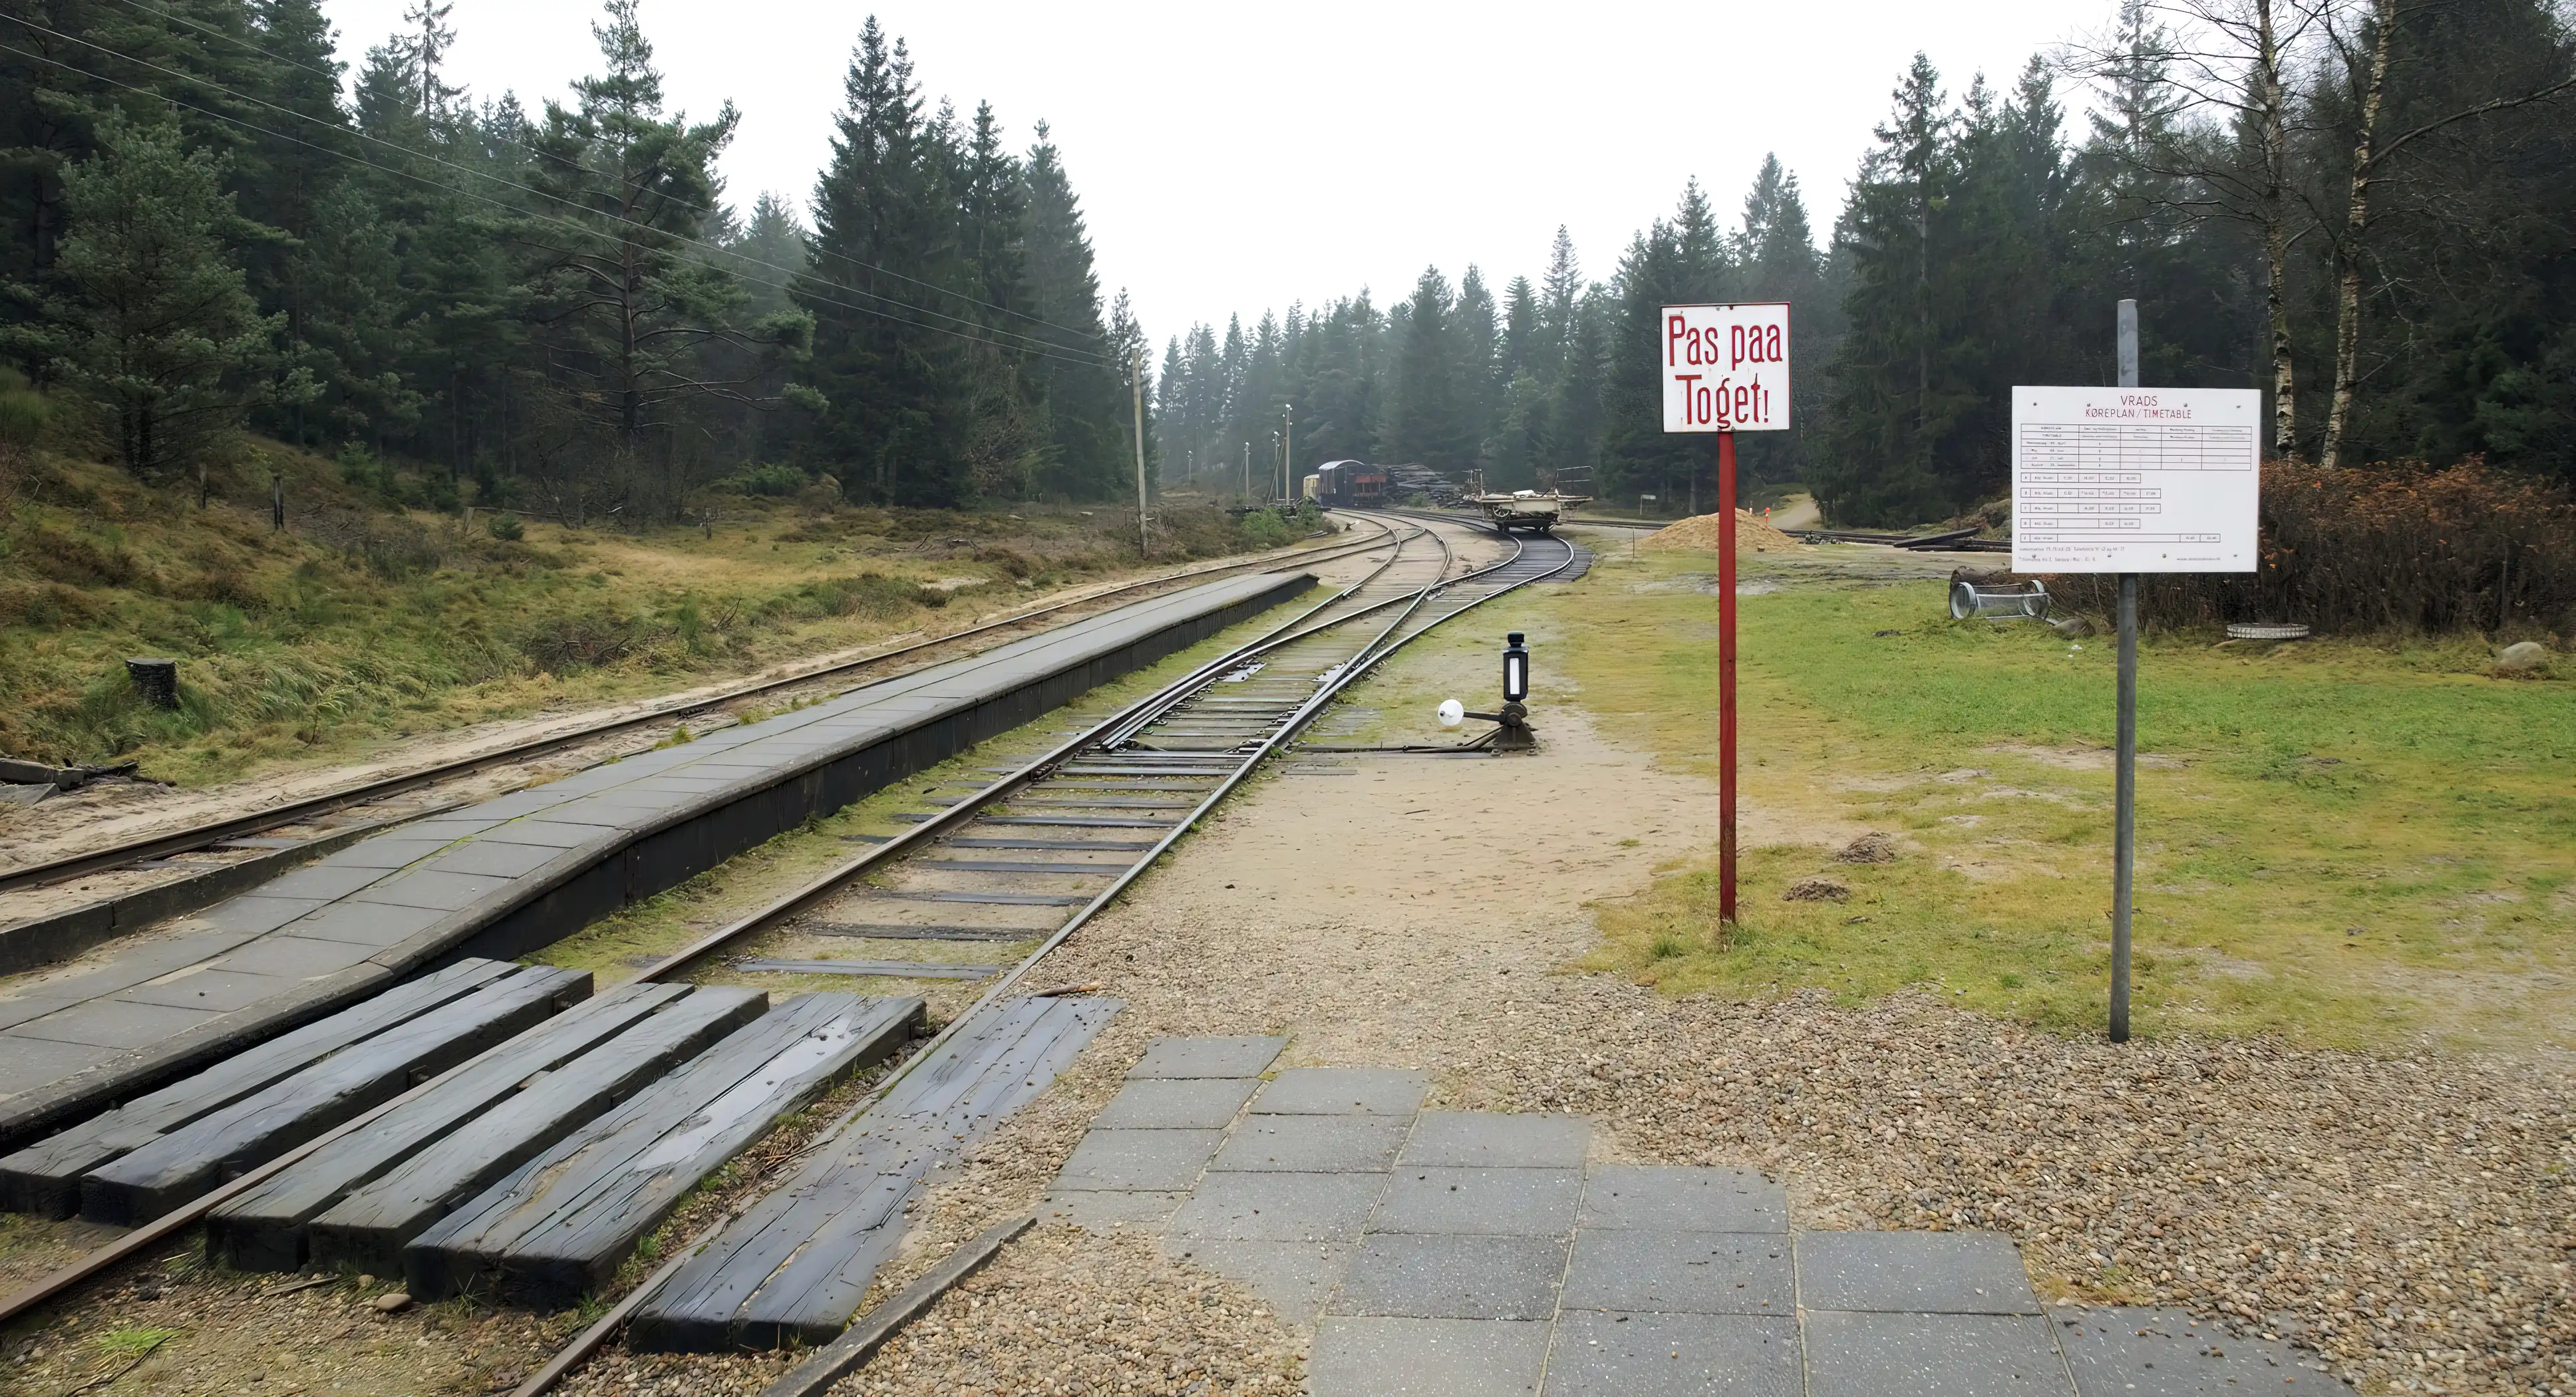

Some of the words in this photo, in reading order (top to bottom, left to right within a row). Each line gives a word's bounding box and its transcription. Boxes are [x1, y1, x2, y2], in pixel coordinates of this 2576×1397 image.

[1669, 315, 1718, 367] Pas
[1731, 324, 1783, 371] paa
[1675, 373, 1769, 430] Toget!
[2120, 395, 2158, 406] VRADS
